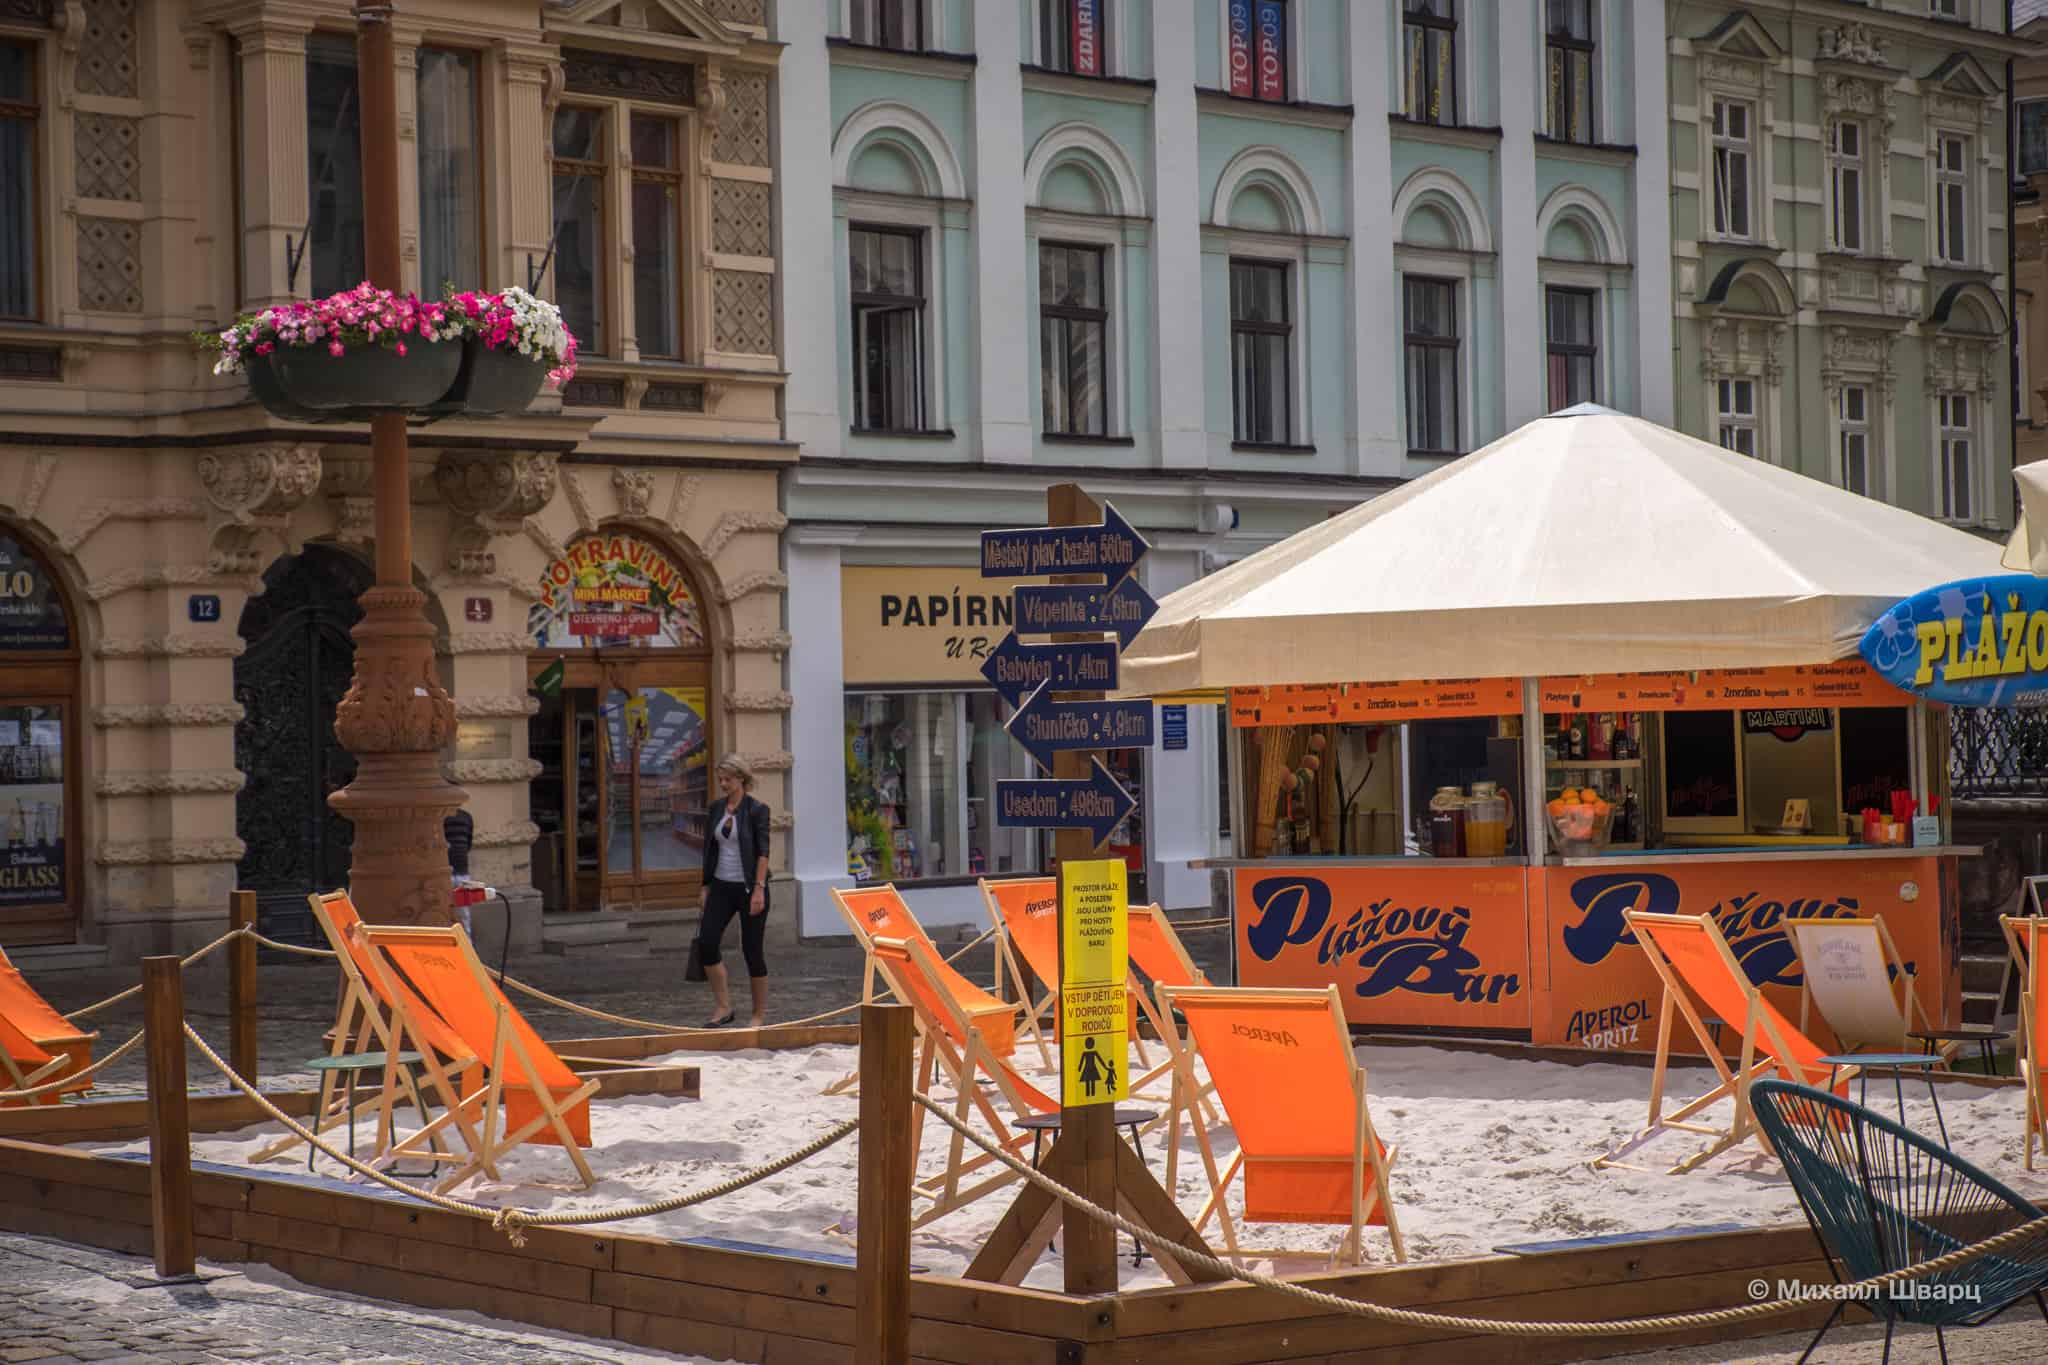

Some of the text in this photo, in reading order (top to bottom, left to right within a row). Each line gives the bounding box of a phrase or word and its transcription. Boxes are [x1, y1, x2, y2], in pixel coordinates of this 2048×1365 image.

[1261, 7, 1280, 92] TOP09
[1062, 535, 1097, 568] bazén
[542, 537, 692, 608] POTRAVINY
[198, 600, 213, 617] 12
[1023, 594, 1086, 628] Vápenka
[996, 652, 1110, 687] Babylon 1,4km
[1026, 711, 1089, 741] Sluníčko
[1747, 708, 1826, 728] MARTINI
[1003, 789, 1057, 817] Usedom
[1247, 876, 1471, 966] Plážový
[1355, 937, 1521, 1004] Bar
[1065, 991, 1092, 1003] VSTUP
[1111, 990, 1125, 1001] JEN
[1068, 1005, 1123, 1018] V DOPROVODU
[1566, 999, 1652, 1042] APEROL
